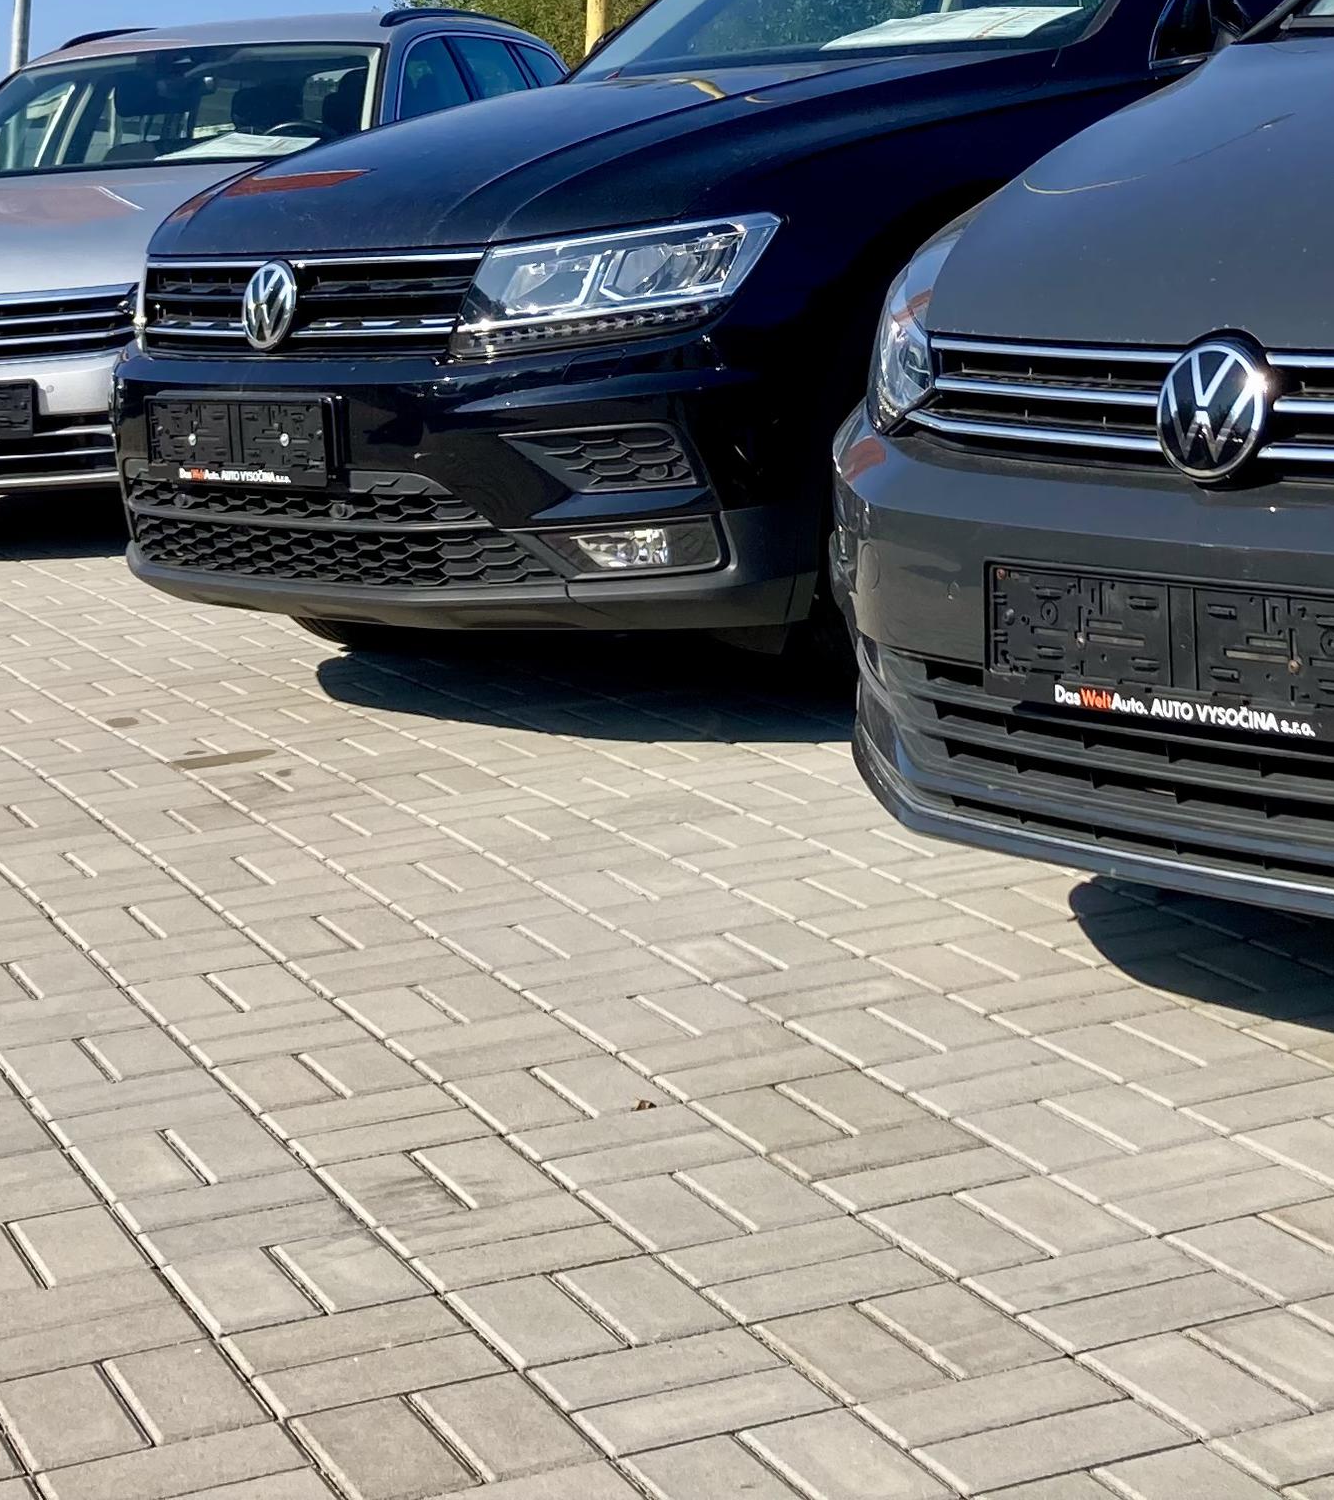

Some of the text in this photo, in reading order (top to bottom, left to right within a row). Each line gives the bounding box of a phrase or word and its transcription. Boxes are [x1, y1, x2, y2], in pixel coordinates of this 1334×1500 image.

[1151, 698, 1194, 721] AUTO
[1196, 704, 1279, 732] VYSOČINA
[1280, 720, 1316, 737] s.r.o.
